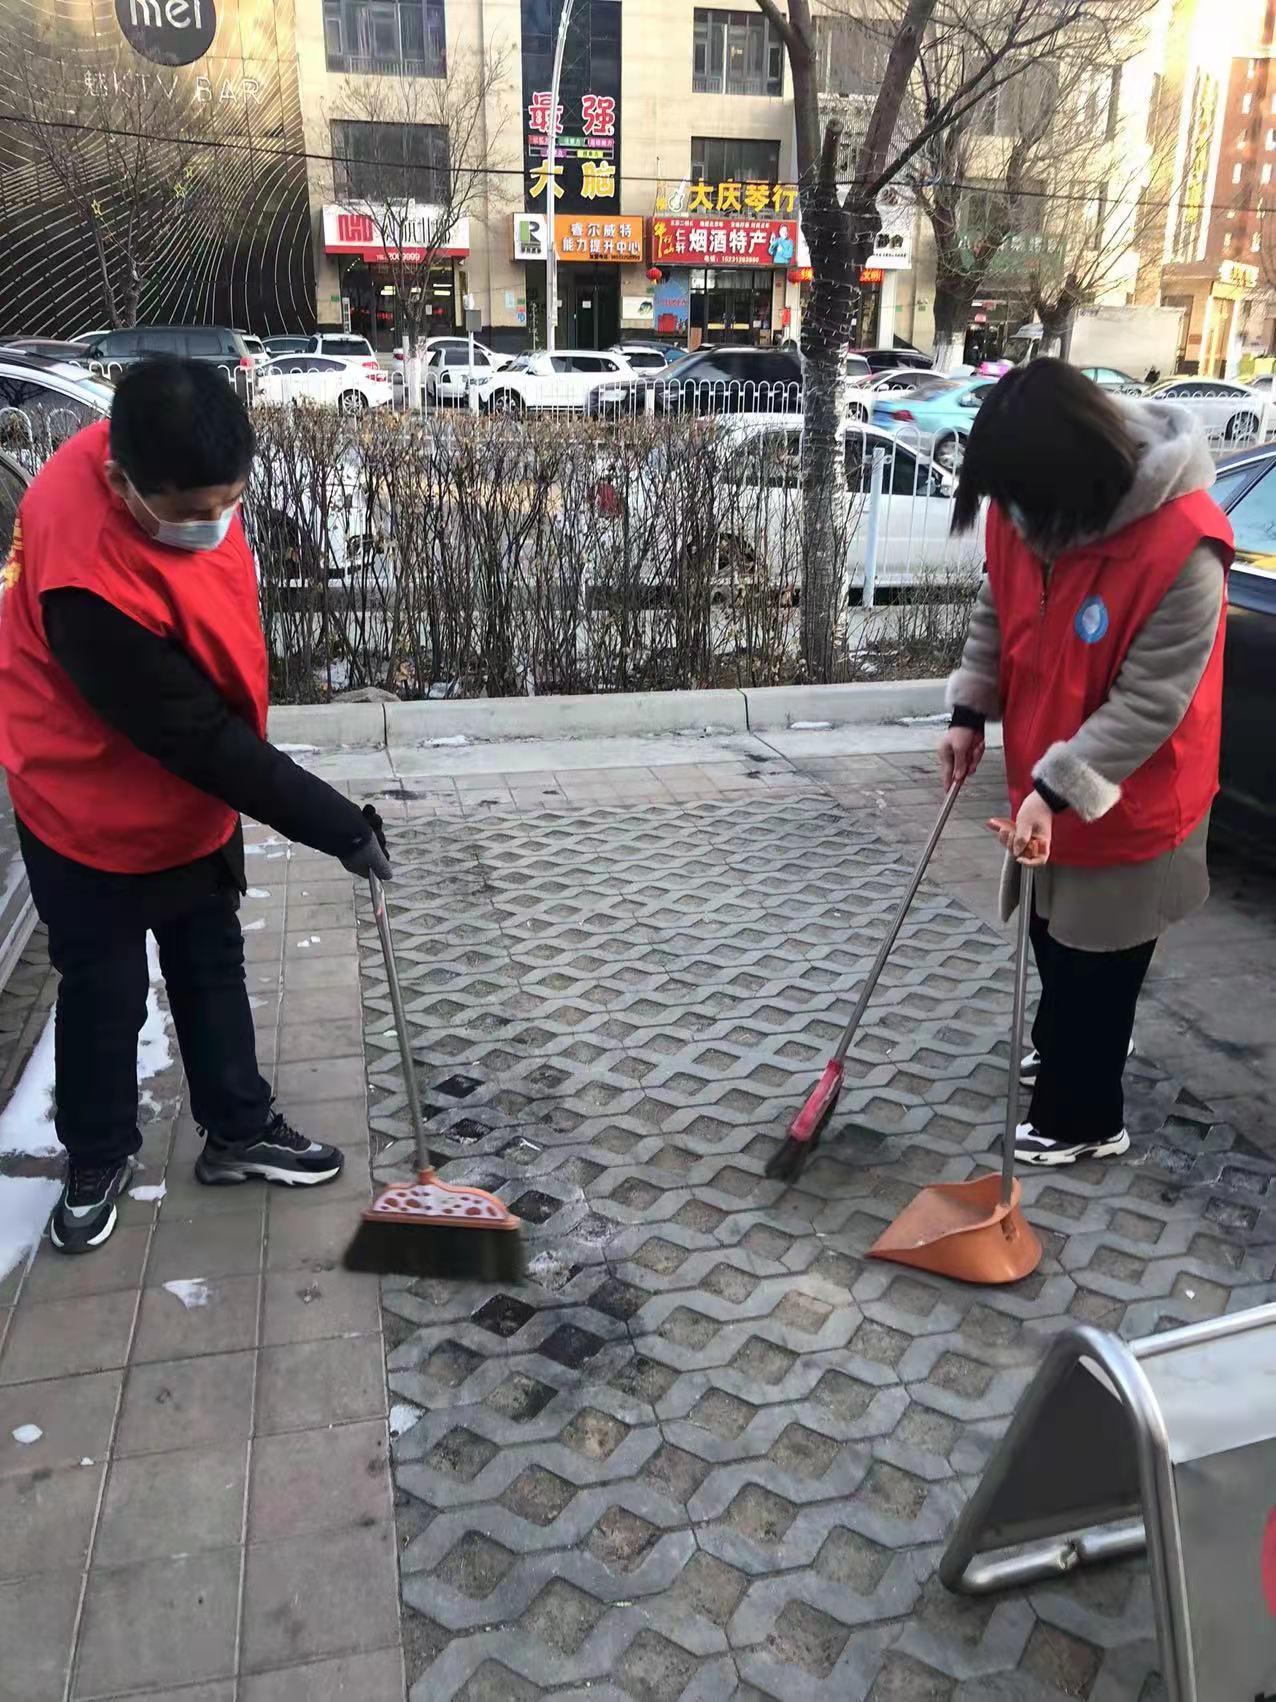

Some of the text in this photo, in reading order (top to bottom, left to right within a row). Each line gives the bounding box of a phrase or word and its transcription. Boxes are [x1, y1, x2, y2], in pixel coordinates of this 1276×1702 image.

[194, 76, 263, 105] BAR
[528, 91, 616, 136] 最强
[529, 160, 616, 200] 大脑
[688, 178, 798, 212] 大庆琴行
[562, 237, 641, 255] 能力提升中心
[688, 228, 768, 254] 烟酒特产
